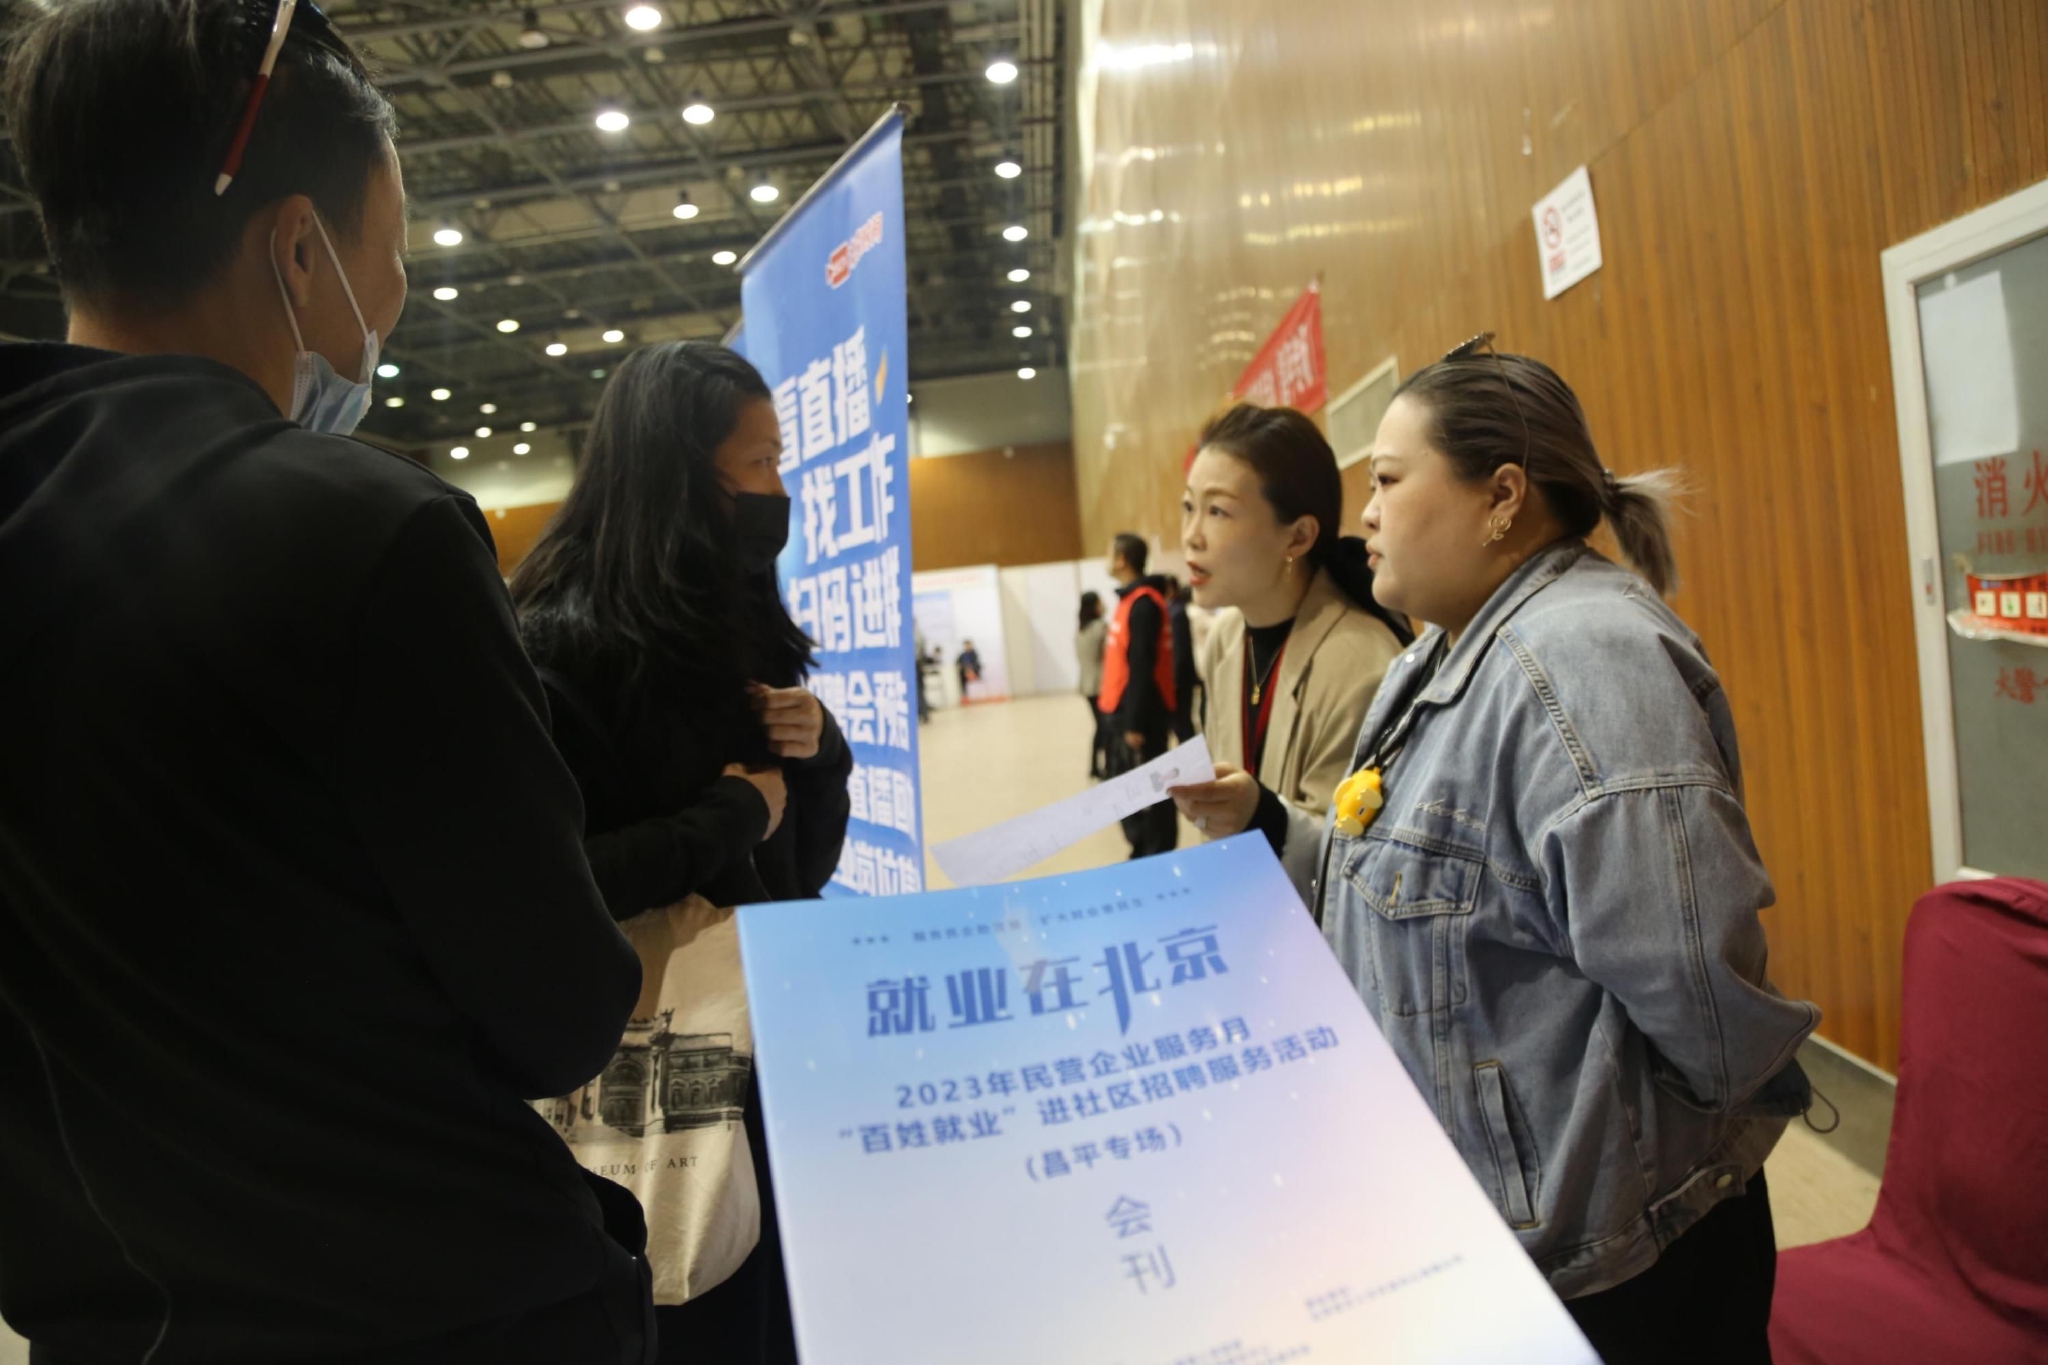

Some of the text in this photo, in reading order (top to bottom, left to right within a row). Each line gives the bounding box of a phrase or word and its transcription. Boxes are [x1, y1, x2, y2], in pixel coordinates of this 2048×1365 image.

[801, 431, 896, 566] 找工作
[866, 924, 1230, 1038] 就业在北京
[894, 1015, 1252, 1109] 2023年民营企业服务月
[667, 1157, 699, 1169] ART
